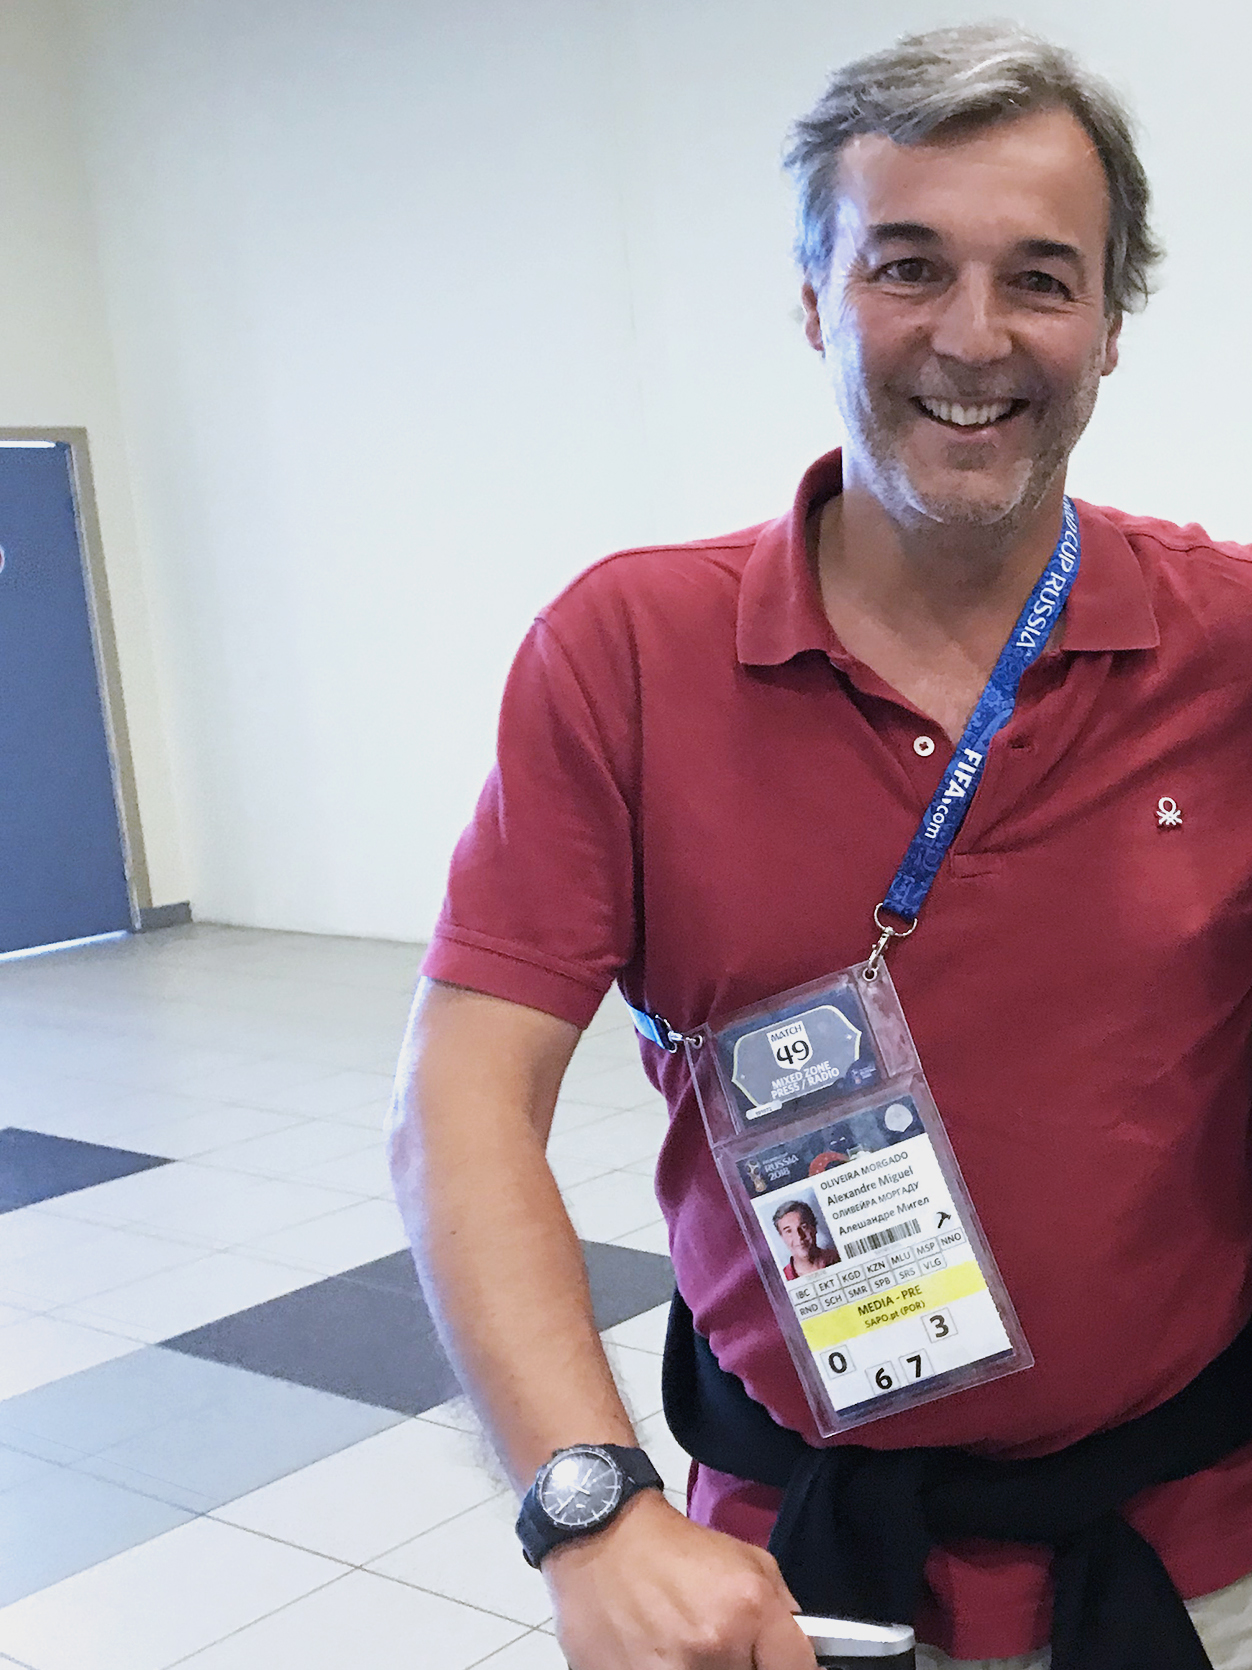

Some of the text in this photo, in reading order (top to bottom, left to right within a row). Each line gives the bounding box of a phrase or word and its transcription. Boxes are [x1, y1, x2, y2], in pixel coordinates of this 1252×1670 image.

[1058, 530, 1079, 573] CUP
[1015, 571, 1067, 648] RUSSIA
[770, 1024, 802, 1042] MATCH
[776, 1040, 810, 1064] 49
[770, 1083, 800, 1099] PRESS
[807, 1067, 840, 1086] RADIO
[771, 1060, 832, 1089] MIXED ZONE
[763, 1154, 799, 1173] RUSSIA
[768, 1168, 791, 1181] 2018
[820, 1151, 909, 1191] OLIVEIRA MORGADO
[827, 1165, 914, 1206] Alexandre Miguel
[832, 1181, 919, 1220] ОЛИВЕЙРА МОРГАДУ
[839, 1196, 930, 1236] Алешандре Мигел
[818, 1279, 835, 1292] EKT
[842, 1270, 861, 1283] KGD
[866, 1261, 886, 1273] KZN
[916, 1241, 935, 1256] MSP
[940, 1232, 962, 1246] NNO
[800, 1257, 942, 1316] RND SCH SMR SPB SRS VLG
[857, 1295, 895, 1316] MEDIA
[901, 1284, 923, 1300] PRE
[864, 1300, 926, 1328] SAPO.pt (POR)
[929, 1314, 949, 1338] 3
[875, 1367, 893, 1390] 6
[906, 1354, 922, 1378] 7
